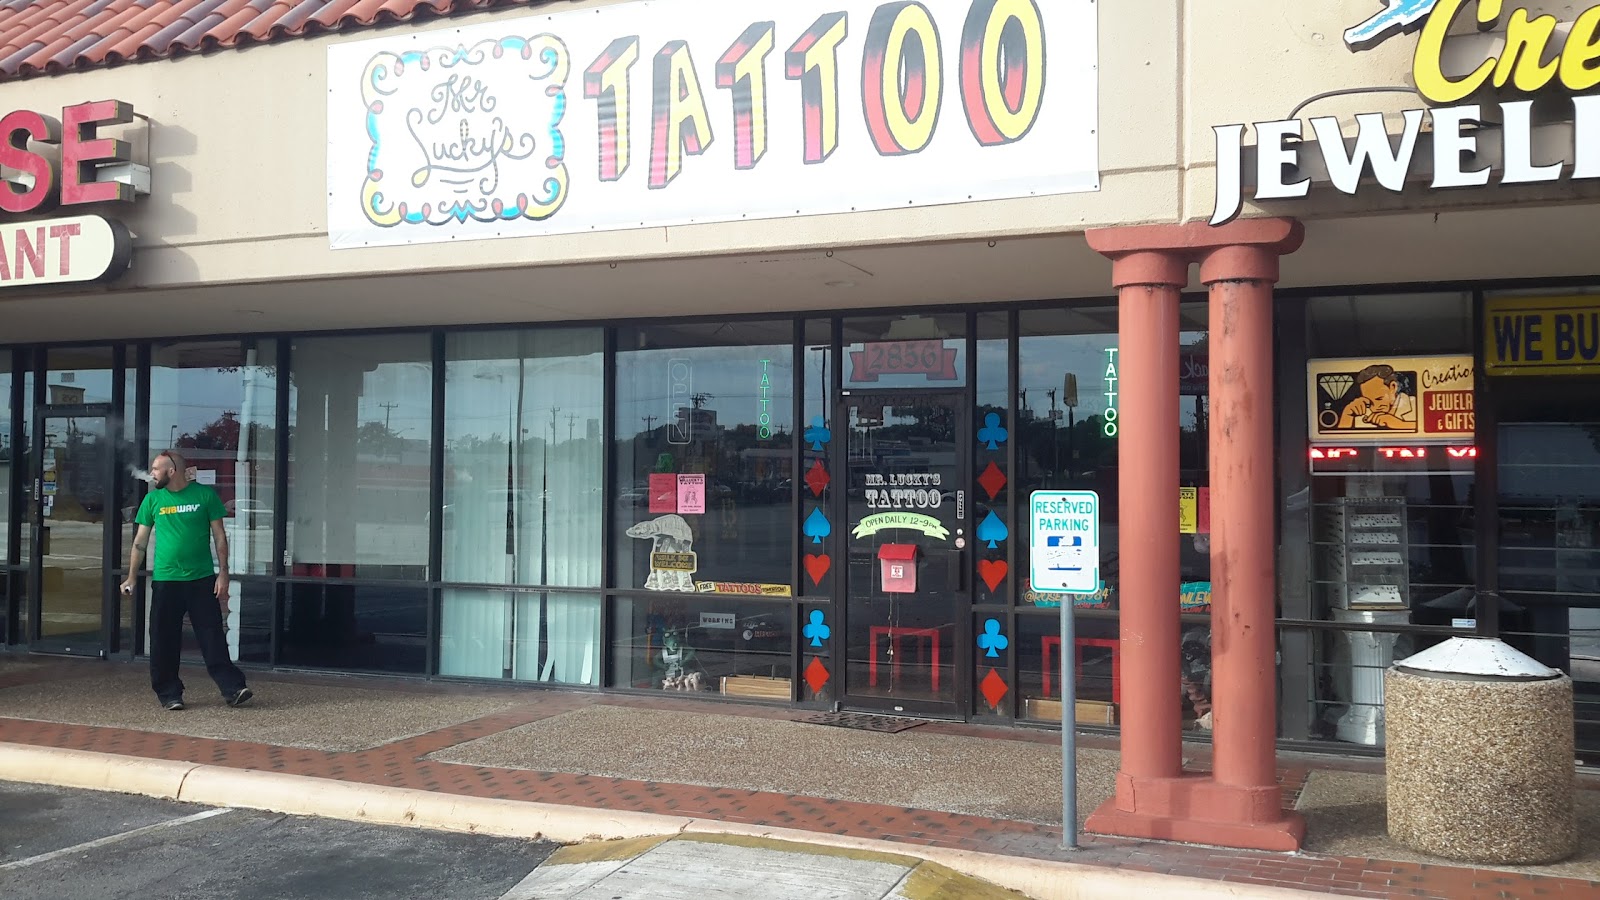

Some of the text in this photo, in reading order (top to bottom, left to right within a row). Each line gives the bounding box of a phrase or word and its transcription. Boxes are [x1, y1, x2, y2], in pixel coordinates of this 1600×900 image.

[428, 73, 497, 124] Mr
[583, 0, 1047, 189] TATTOO
[405, 108, 536, 195] Lucky's
[1493, 313, 1542, 362] WE
[868, 342, 938, 369] 2856
[759, 359, 771, 439] TATTOO
[1104, 348, 1118, 437] TATTOO
[1437, 412, 1475, 430] & GIFTS
[865, 473, 941, 486] MR. LUCKY'S
[865, 489, 941, 508] TATTOO
[1035, 501, 1093, 514] RESERVED
[159, 504, 199, 515] SUBWAY
[865, 516, 884, 528] OPEN
[885, 515, 907, 525] DAILY
[1039, 518, 1089, 531] PARKING
[654, 560, 693, 569] WELCOME
[716, 583, 762, 594] TATTOOS
